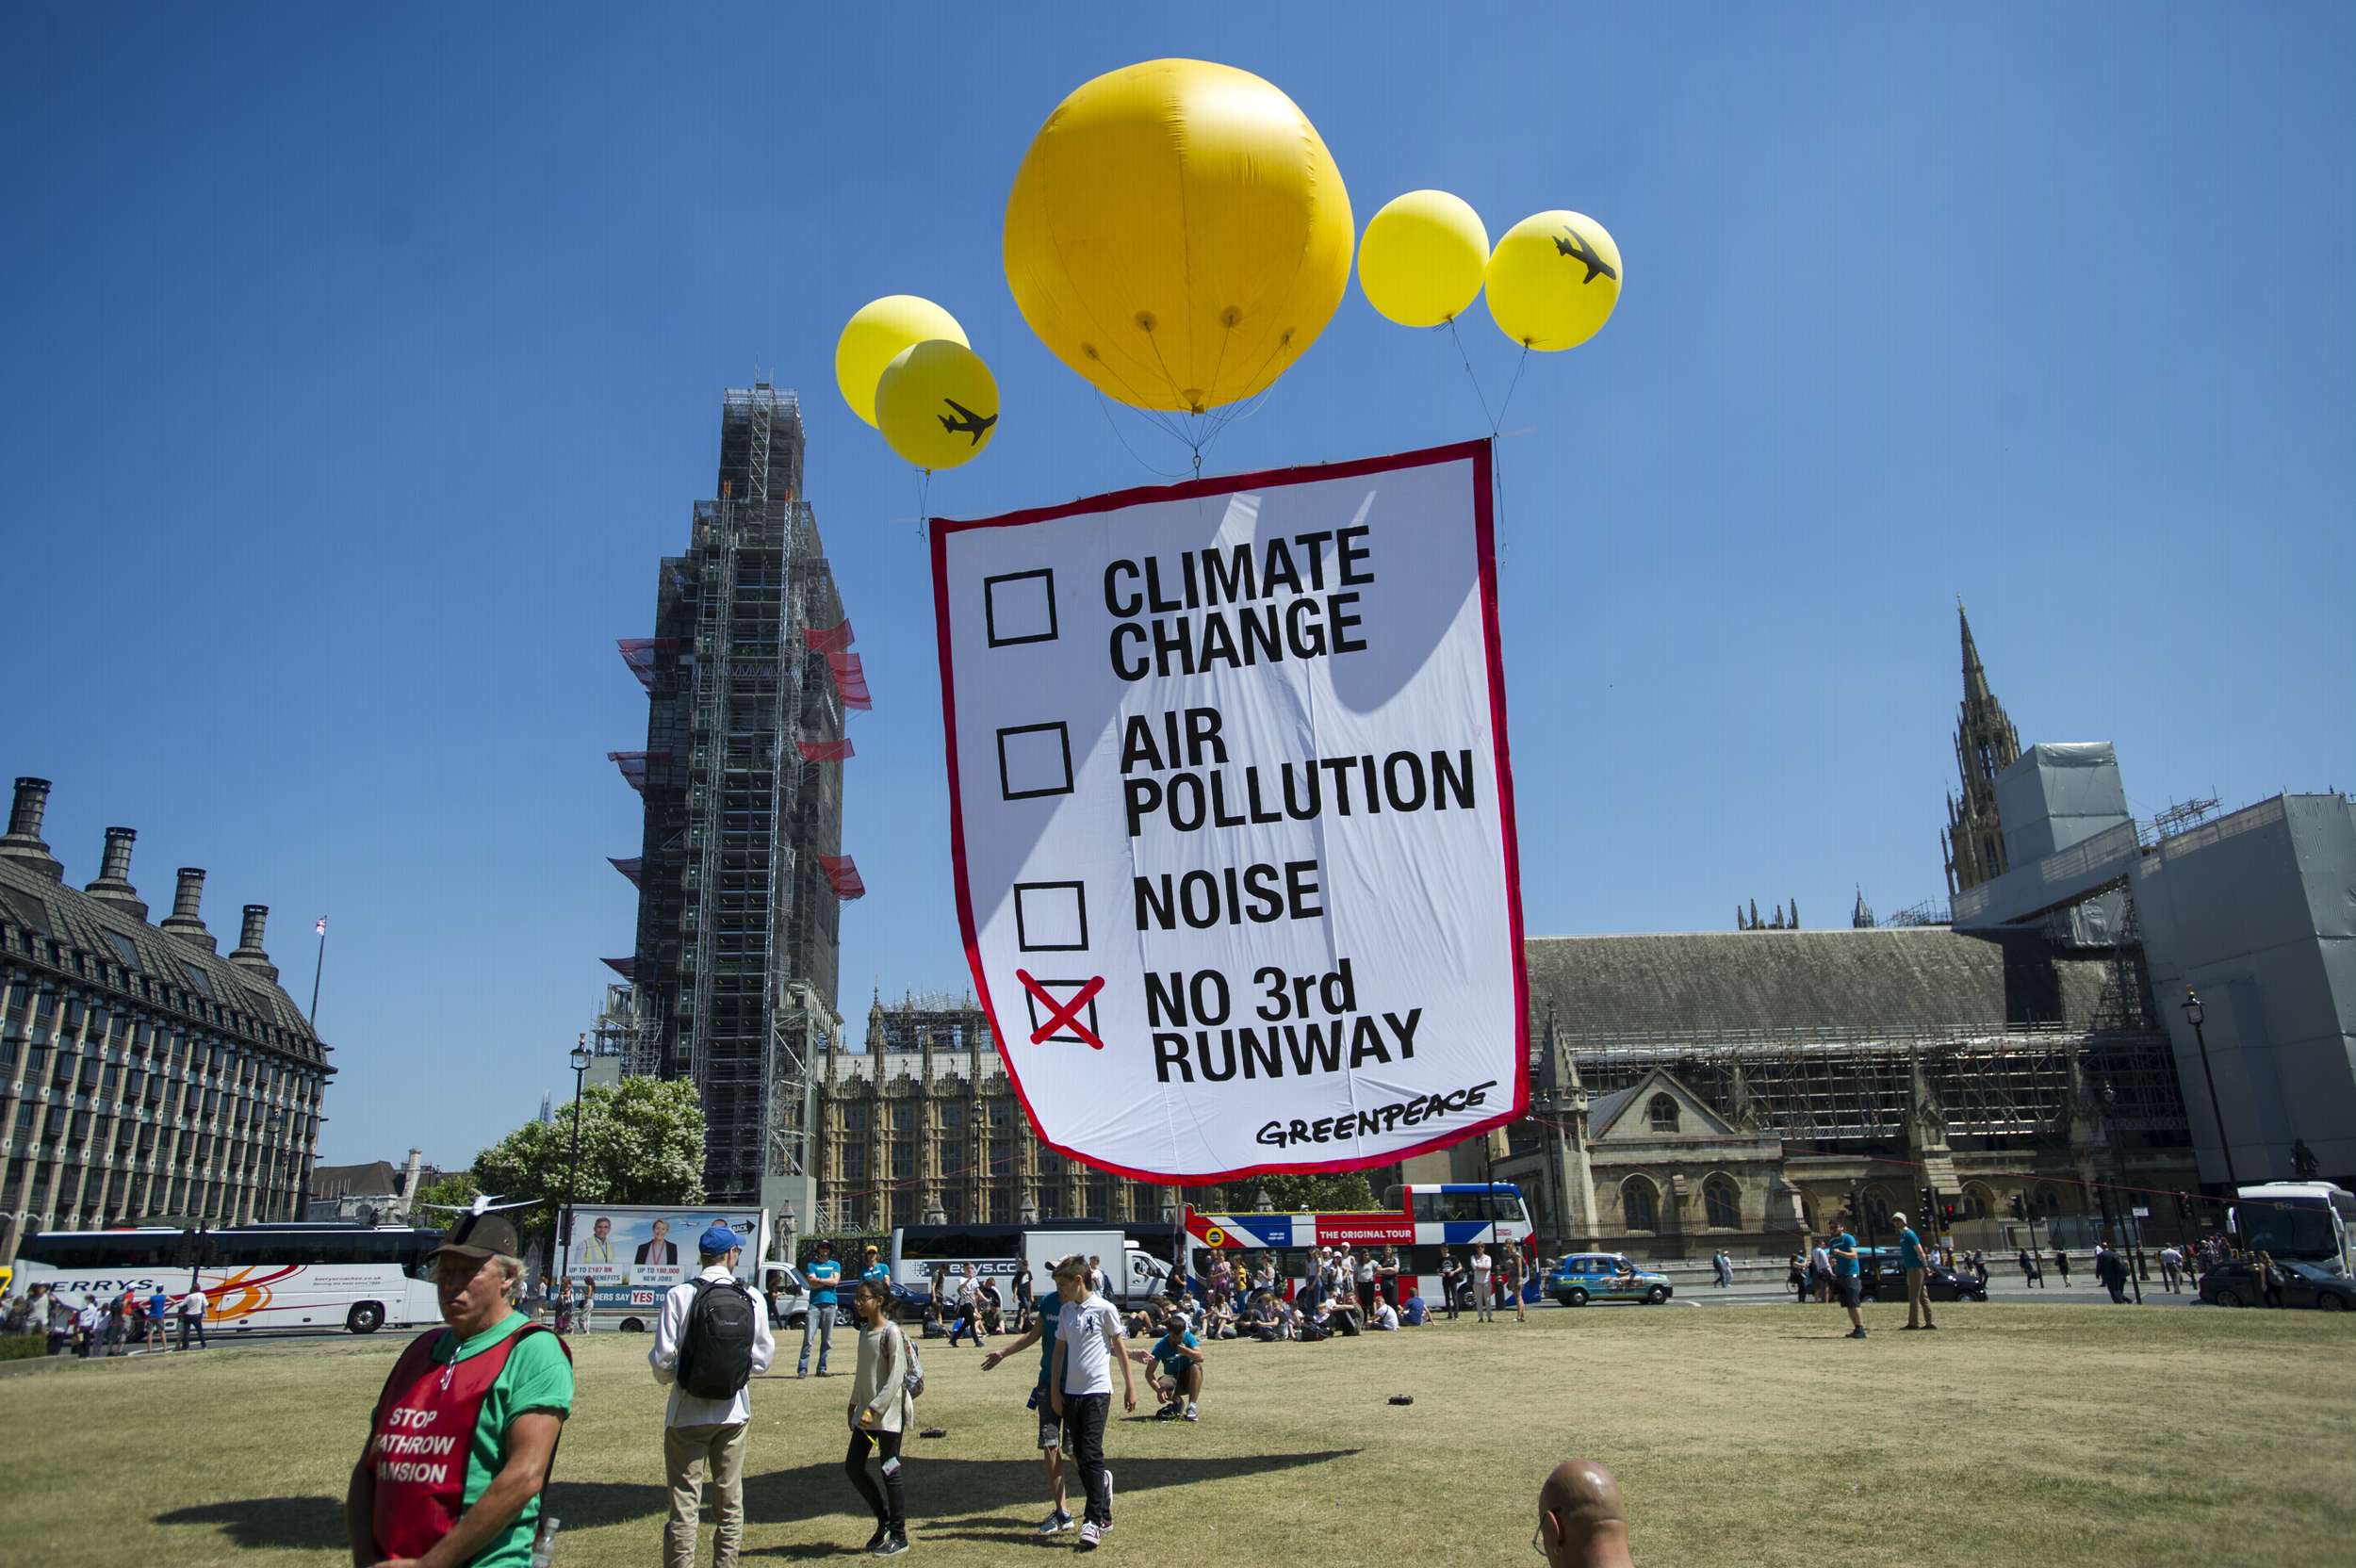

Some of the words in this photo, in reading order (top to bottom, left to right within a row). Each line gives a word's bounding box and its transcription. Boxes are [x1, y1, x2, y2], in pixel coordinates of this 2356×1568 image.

[1104, 525, 1374, 618] CLIMATE
[1110, 592, 1367, 681] CHANGE
[1120, 707, 1229, 774] AIR
[1124, 749, 1475, 837] POLLUTION
[1134, 859, 1323, 931] NOISE
[1144, 969, 1230, 1027] NO
[1252, 958, 1357, 1021] 3rd
[1152, 1007, 1422, 1083] RUNWAY
[1255, 1081, 1497, 1148] GREENPEACE
[732, 1224, 747, 1233] BACK
[1319, 1231, 1339, 1239] THE
[1341, 1230, 1385, 1238] ORIGINAL
[1386, 1230, 1412, 1238] TOUR
[27, 1279, 154, 1293] ERRYS
[575, 1292, 614, 1301] MBERS
[614, 1293, 630, 1301] SAY
[632, 1292, 653, 1303] YES
[375, 1433, 456, 1456] ATHROW
[389, 1407, 437, 1429] STOP
[377, 1462, 448, 1484] ANSION
